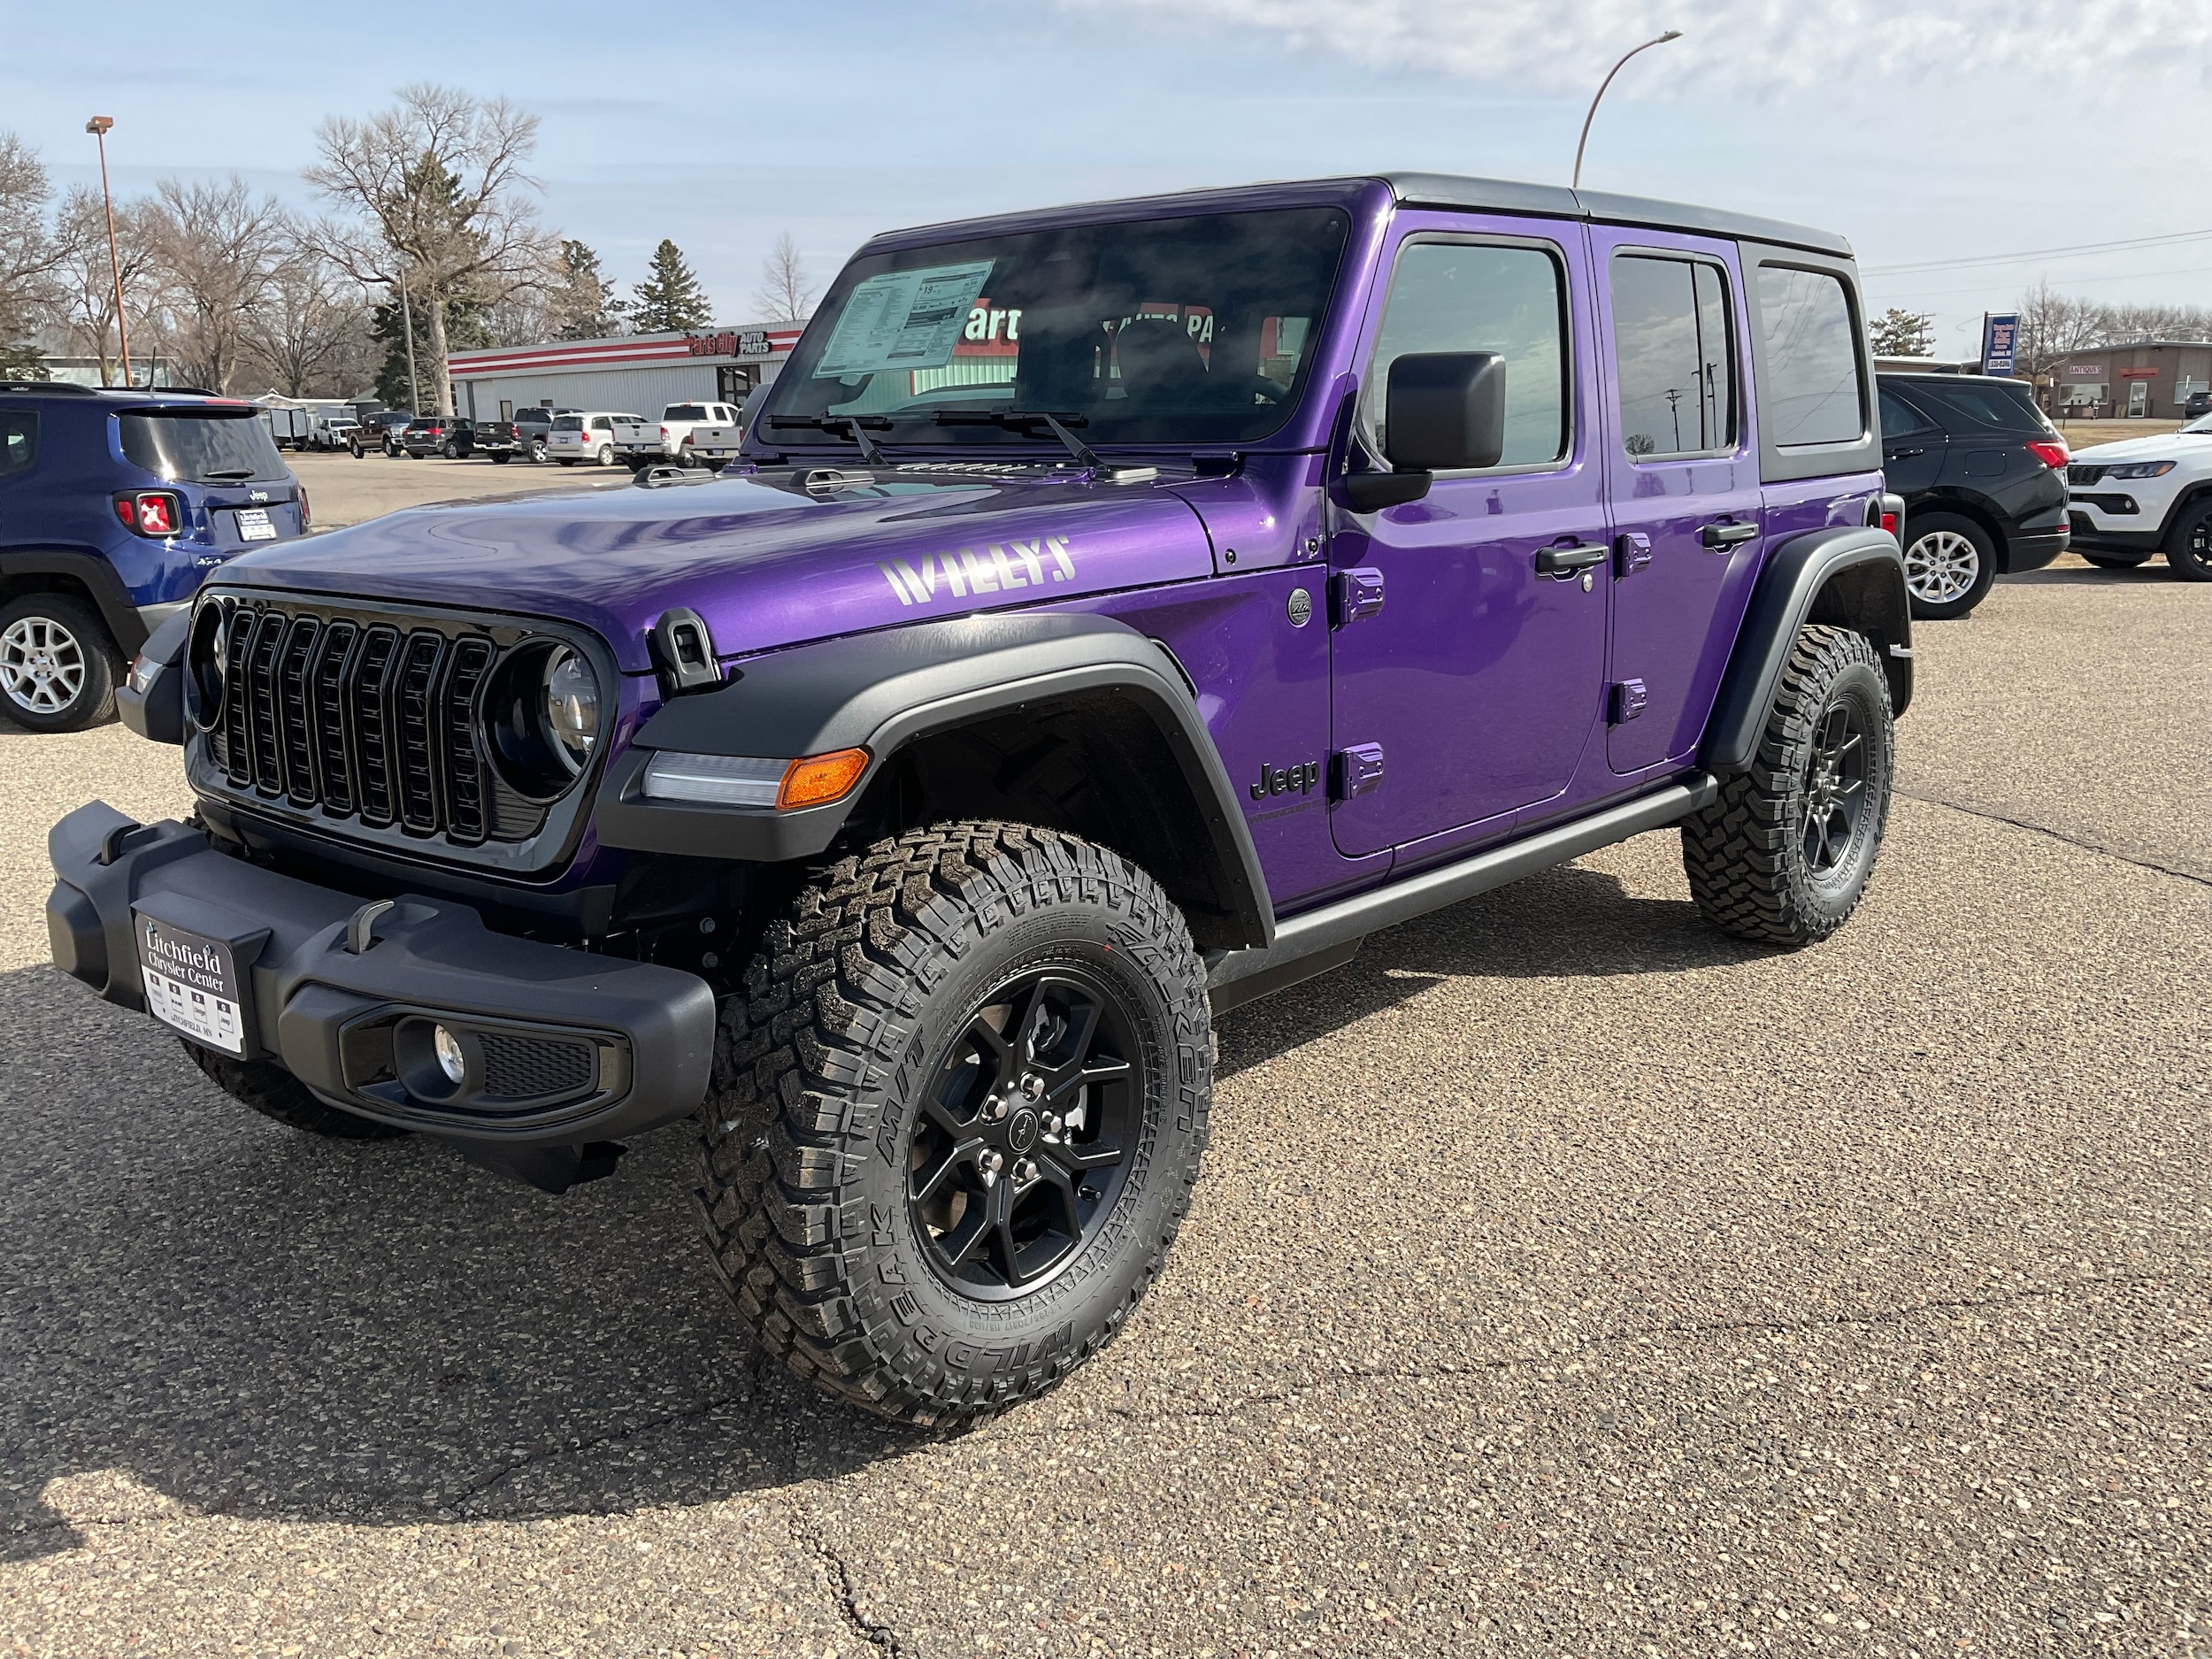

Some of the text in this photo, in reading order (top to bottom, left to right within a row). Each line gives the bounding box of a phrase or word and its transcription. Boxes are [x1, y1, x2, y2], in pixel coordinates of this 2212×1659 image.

[923, 284, 933, 296] 19
[740, 332, 764, 343] AUTO
[964, 307, 1022, 341] art
[1187, 315, 1214, 343] PA
[688, 333, 738, 358] Parts City
[740, 342, 770, 354] PARTS
[2069, 365, 2102, 374] ANTIQUES
[249, 489, 269, 503] Jeep
[875, 534, 1075, 606] WILLYS
[1249, 760, 1320, 802] Jeep
[146, 929, 222, 975] Litchfield
[148, 951, 224, 993] Chrysler Center
[1105, 920, 1195, 1133] FALKEN
[870, 1202, 1072, 1371] WILDPEAK
